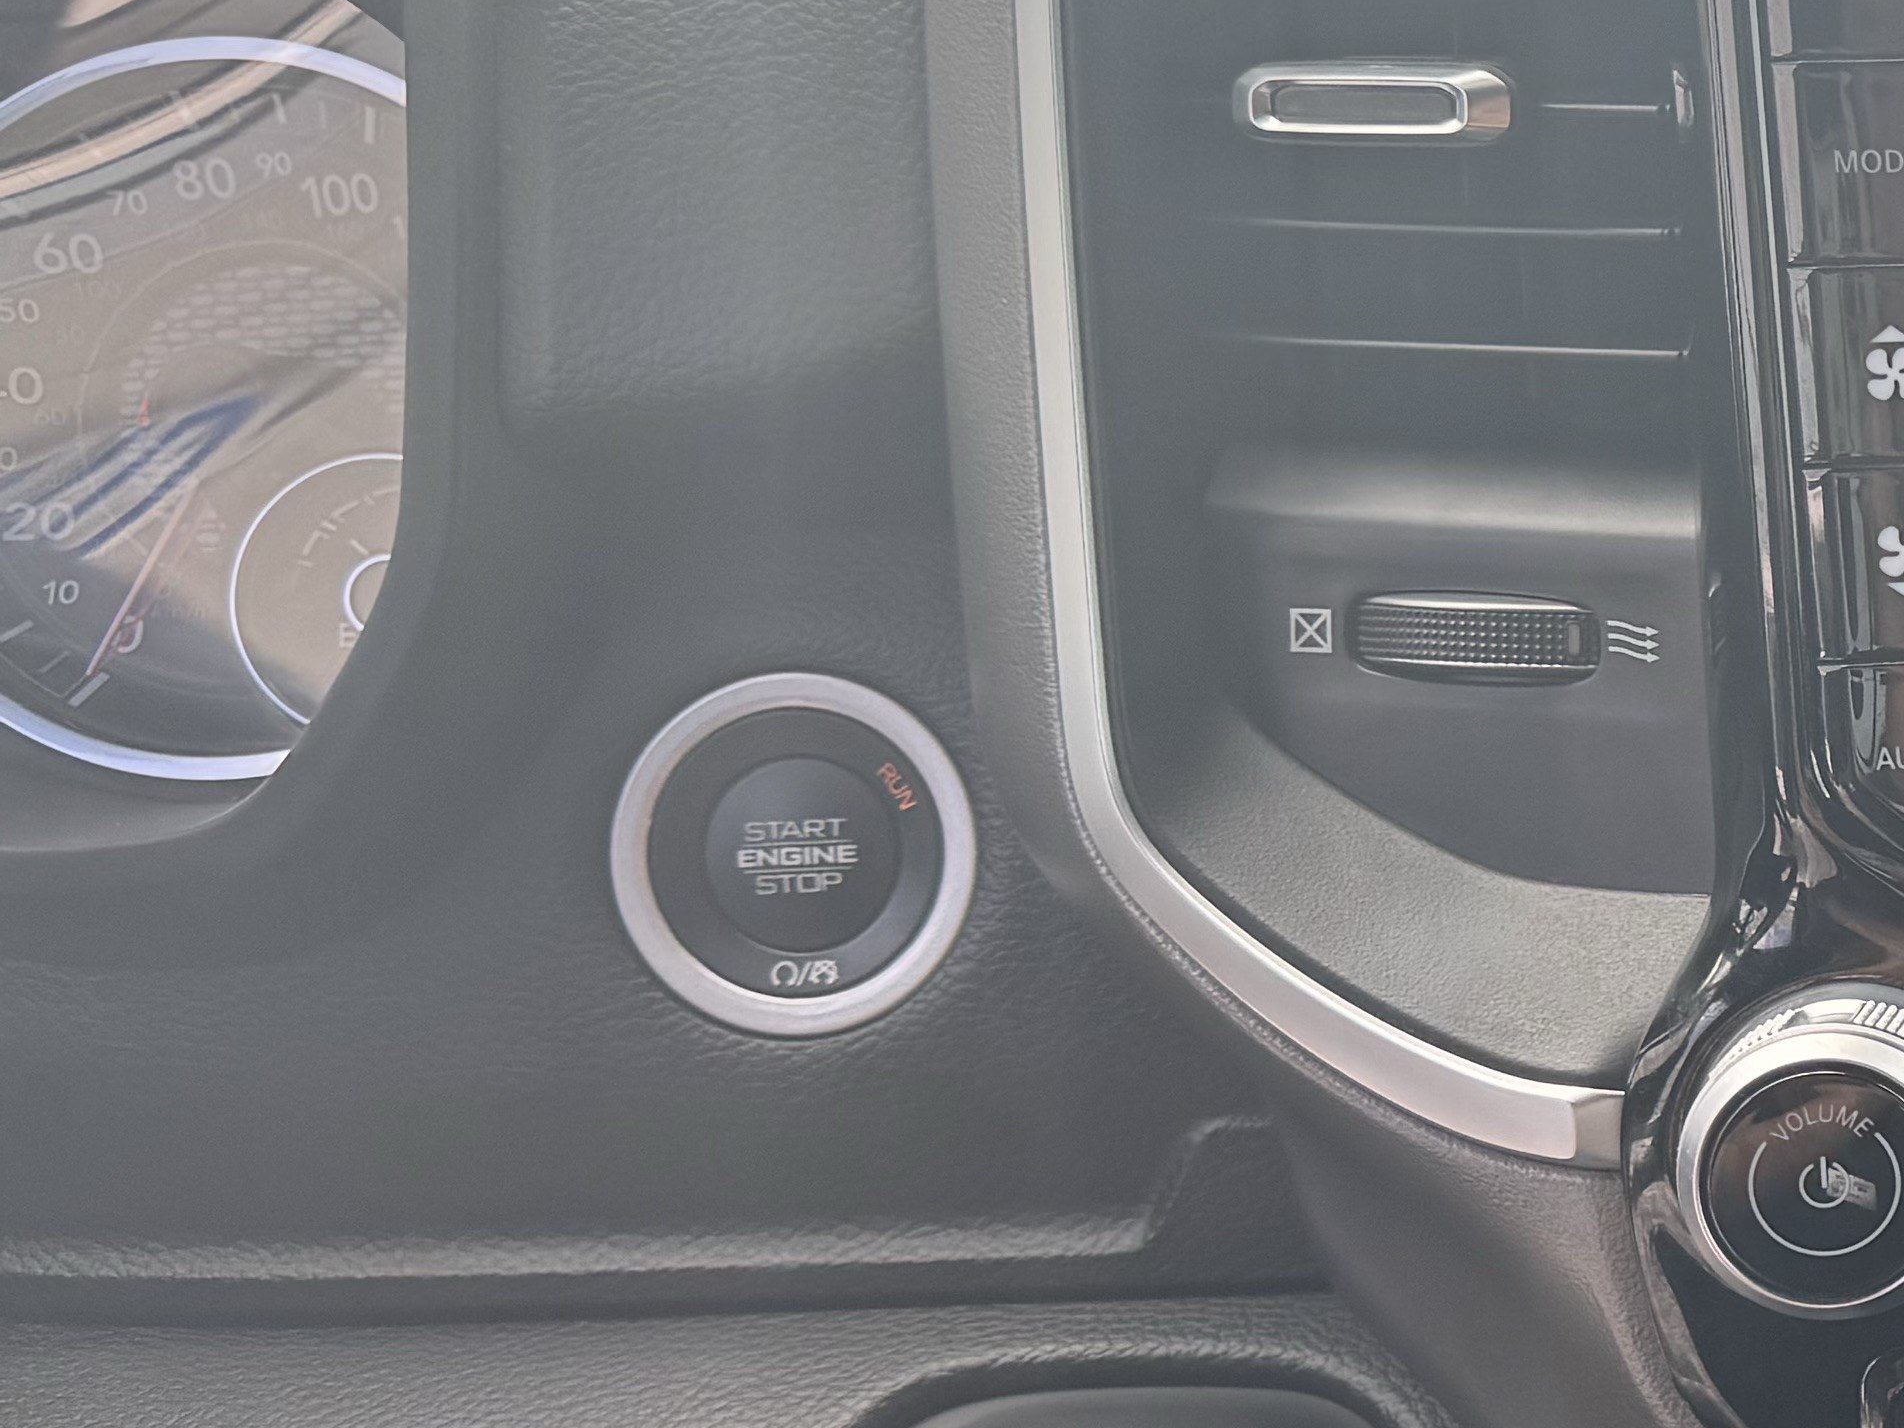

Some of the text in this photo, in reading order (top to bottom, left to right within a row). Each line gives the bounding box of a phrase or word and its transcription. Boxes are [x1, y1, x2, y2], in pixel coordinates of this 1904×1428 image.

[174, 158, 237, 201] 80
[255, 151, 292, 179] 90
[107, 188, 149, 217] 70
[301, 172, 379, 220] 100
[34, 232, 104, 275] 60
[2, 502, 76, 542] 20
[43, 579, 80, 606] 10
[876, 762, 917, 812] RUN
[744, 818, 849, 842] START
[737, 844, 860, 869] ENGINE
[754, 871, 843, 896] STOP
[1770, 1104, 1874, 1142] VOLUME
